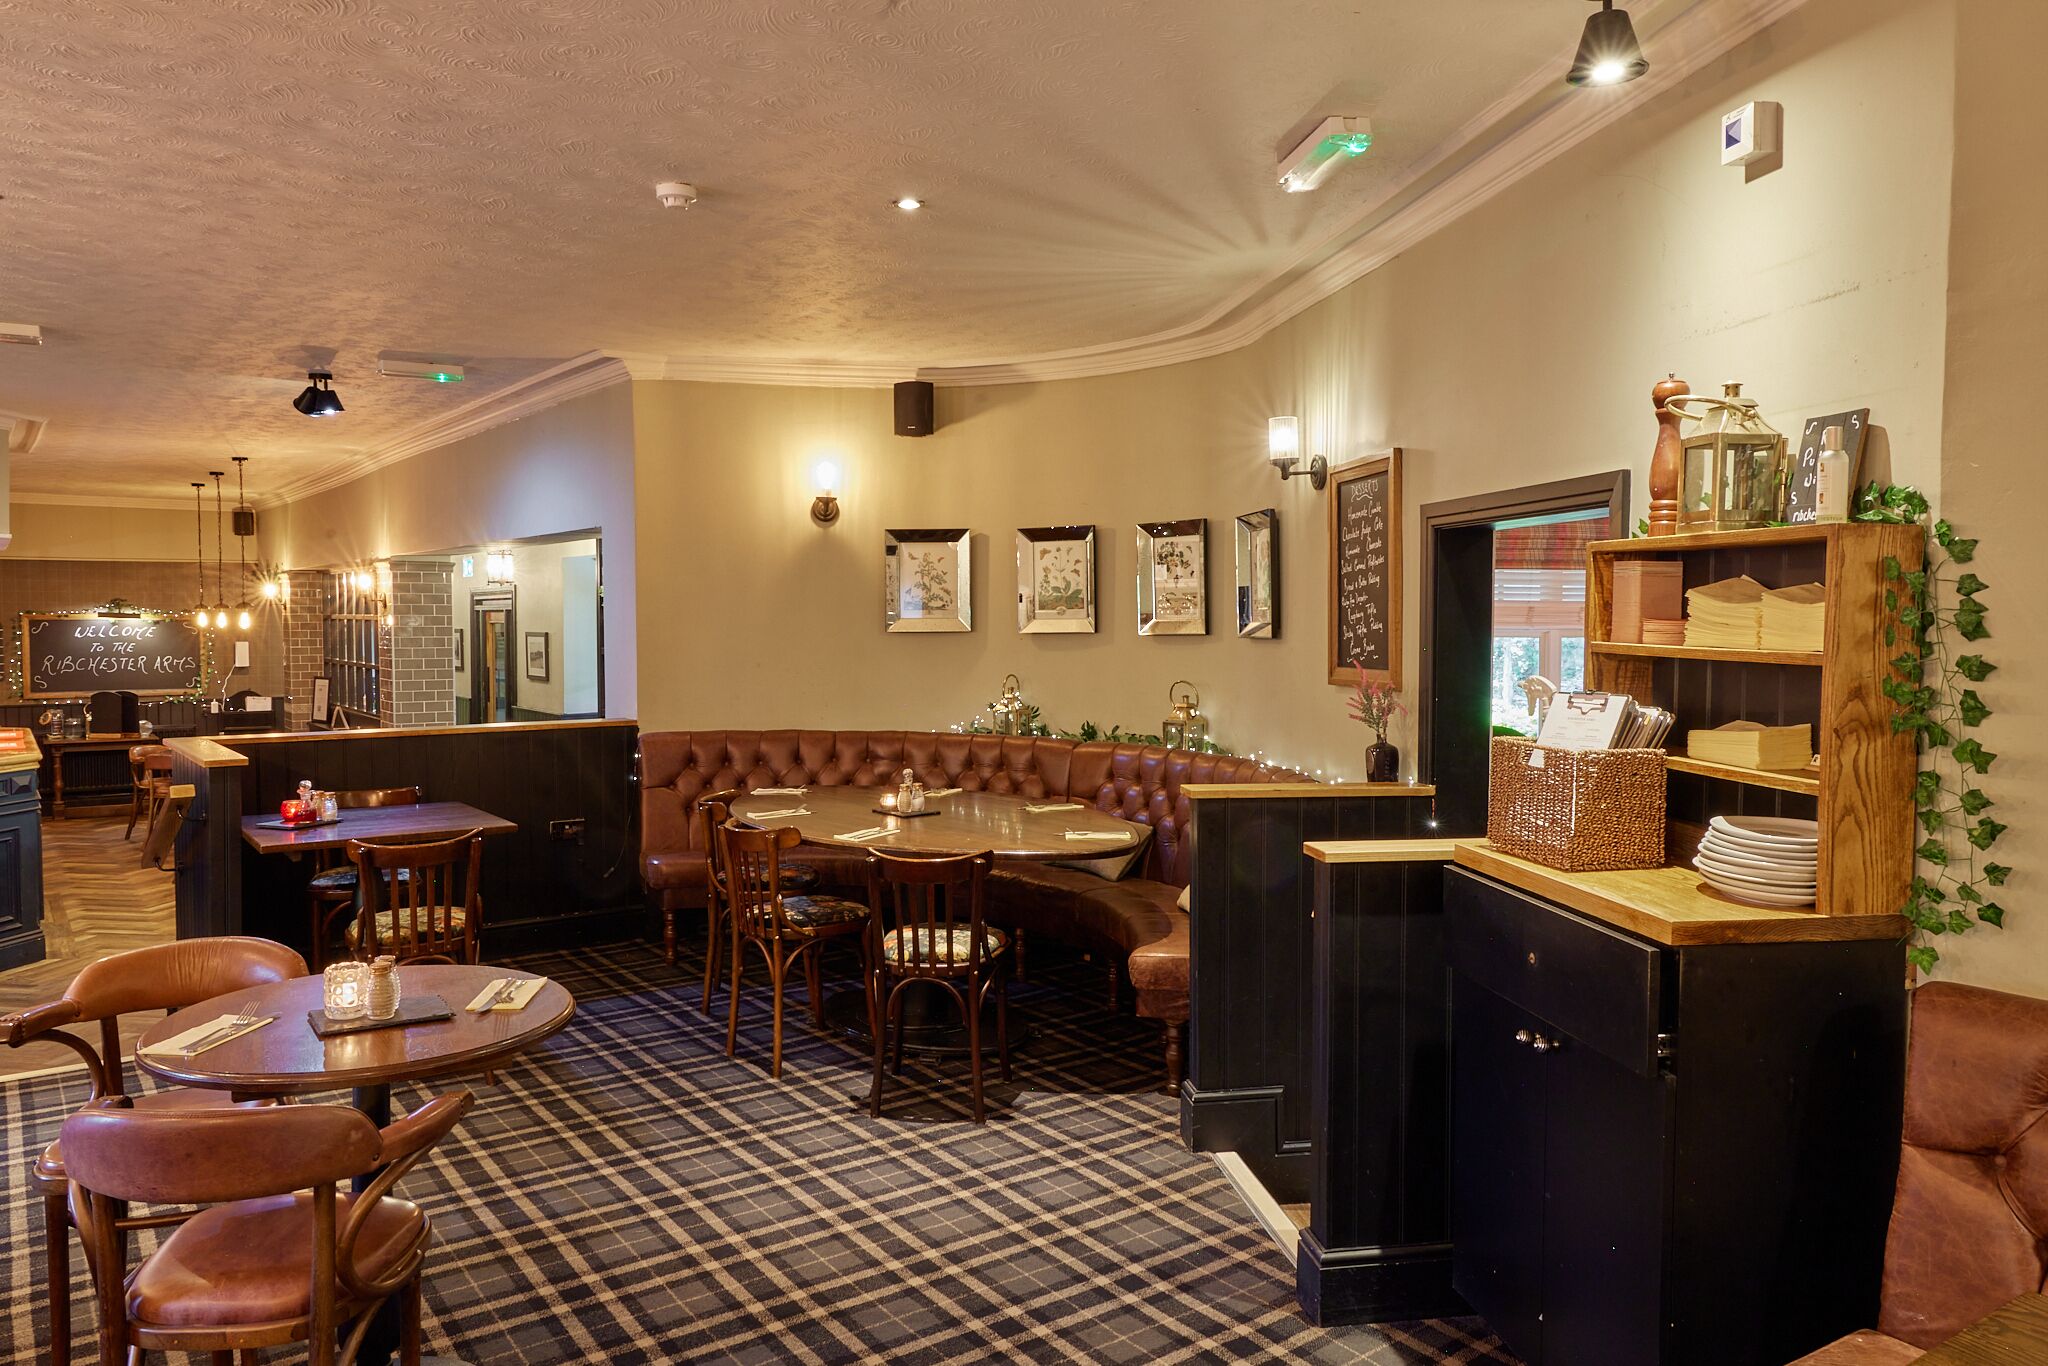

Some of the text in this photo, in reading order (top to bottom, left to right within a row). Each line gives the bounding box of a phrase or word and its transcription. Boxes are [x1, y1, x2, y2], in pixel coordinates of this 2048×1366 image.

[1351, 479, 1379, 502] DESSERTS
[75, 625, 157, 640] WELCOME
[113, 642, 136, 654] THE
[42, 655, 196, 676] RIBCHESTER ARMS
